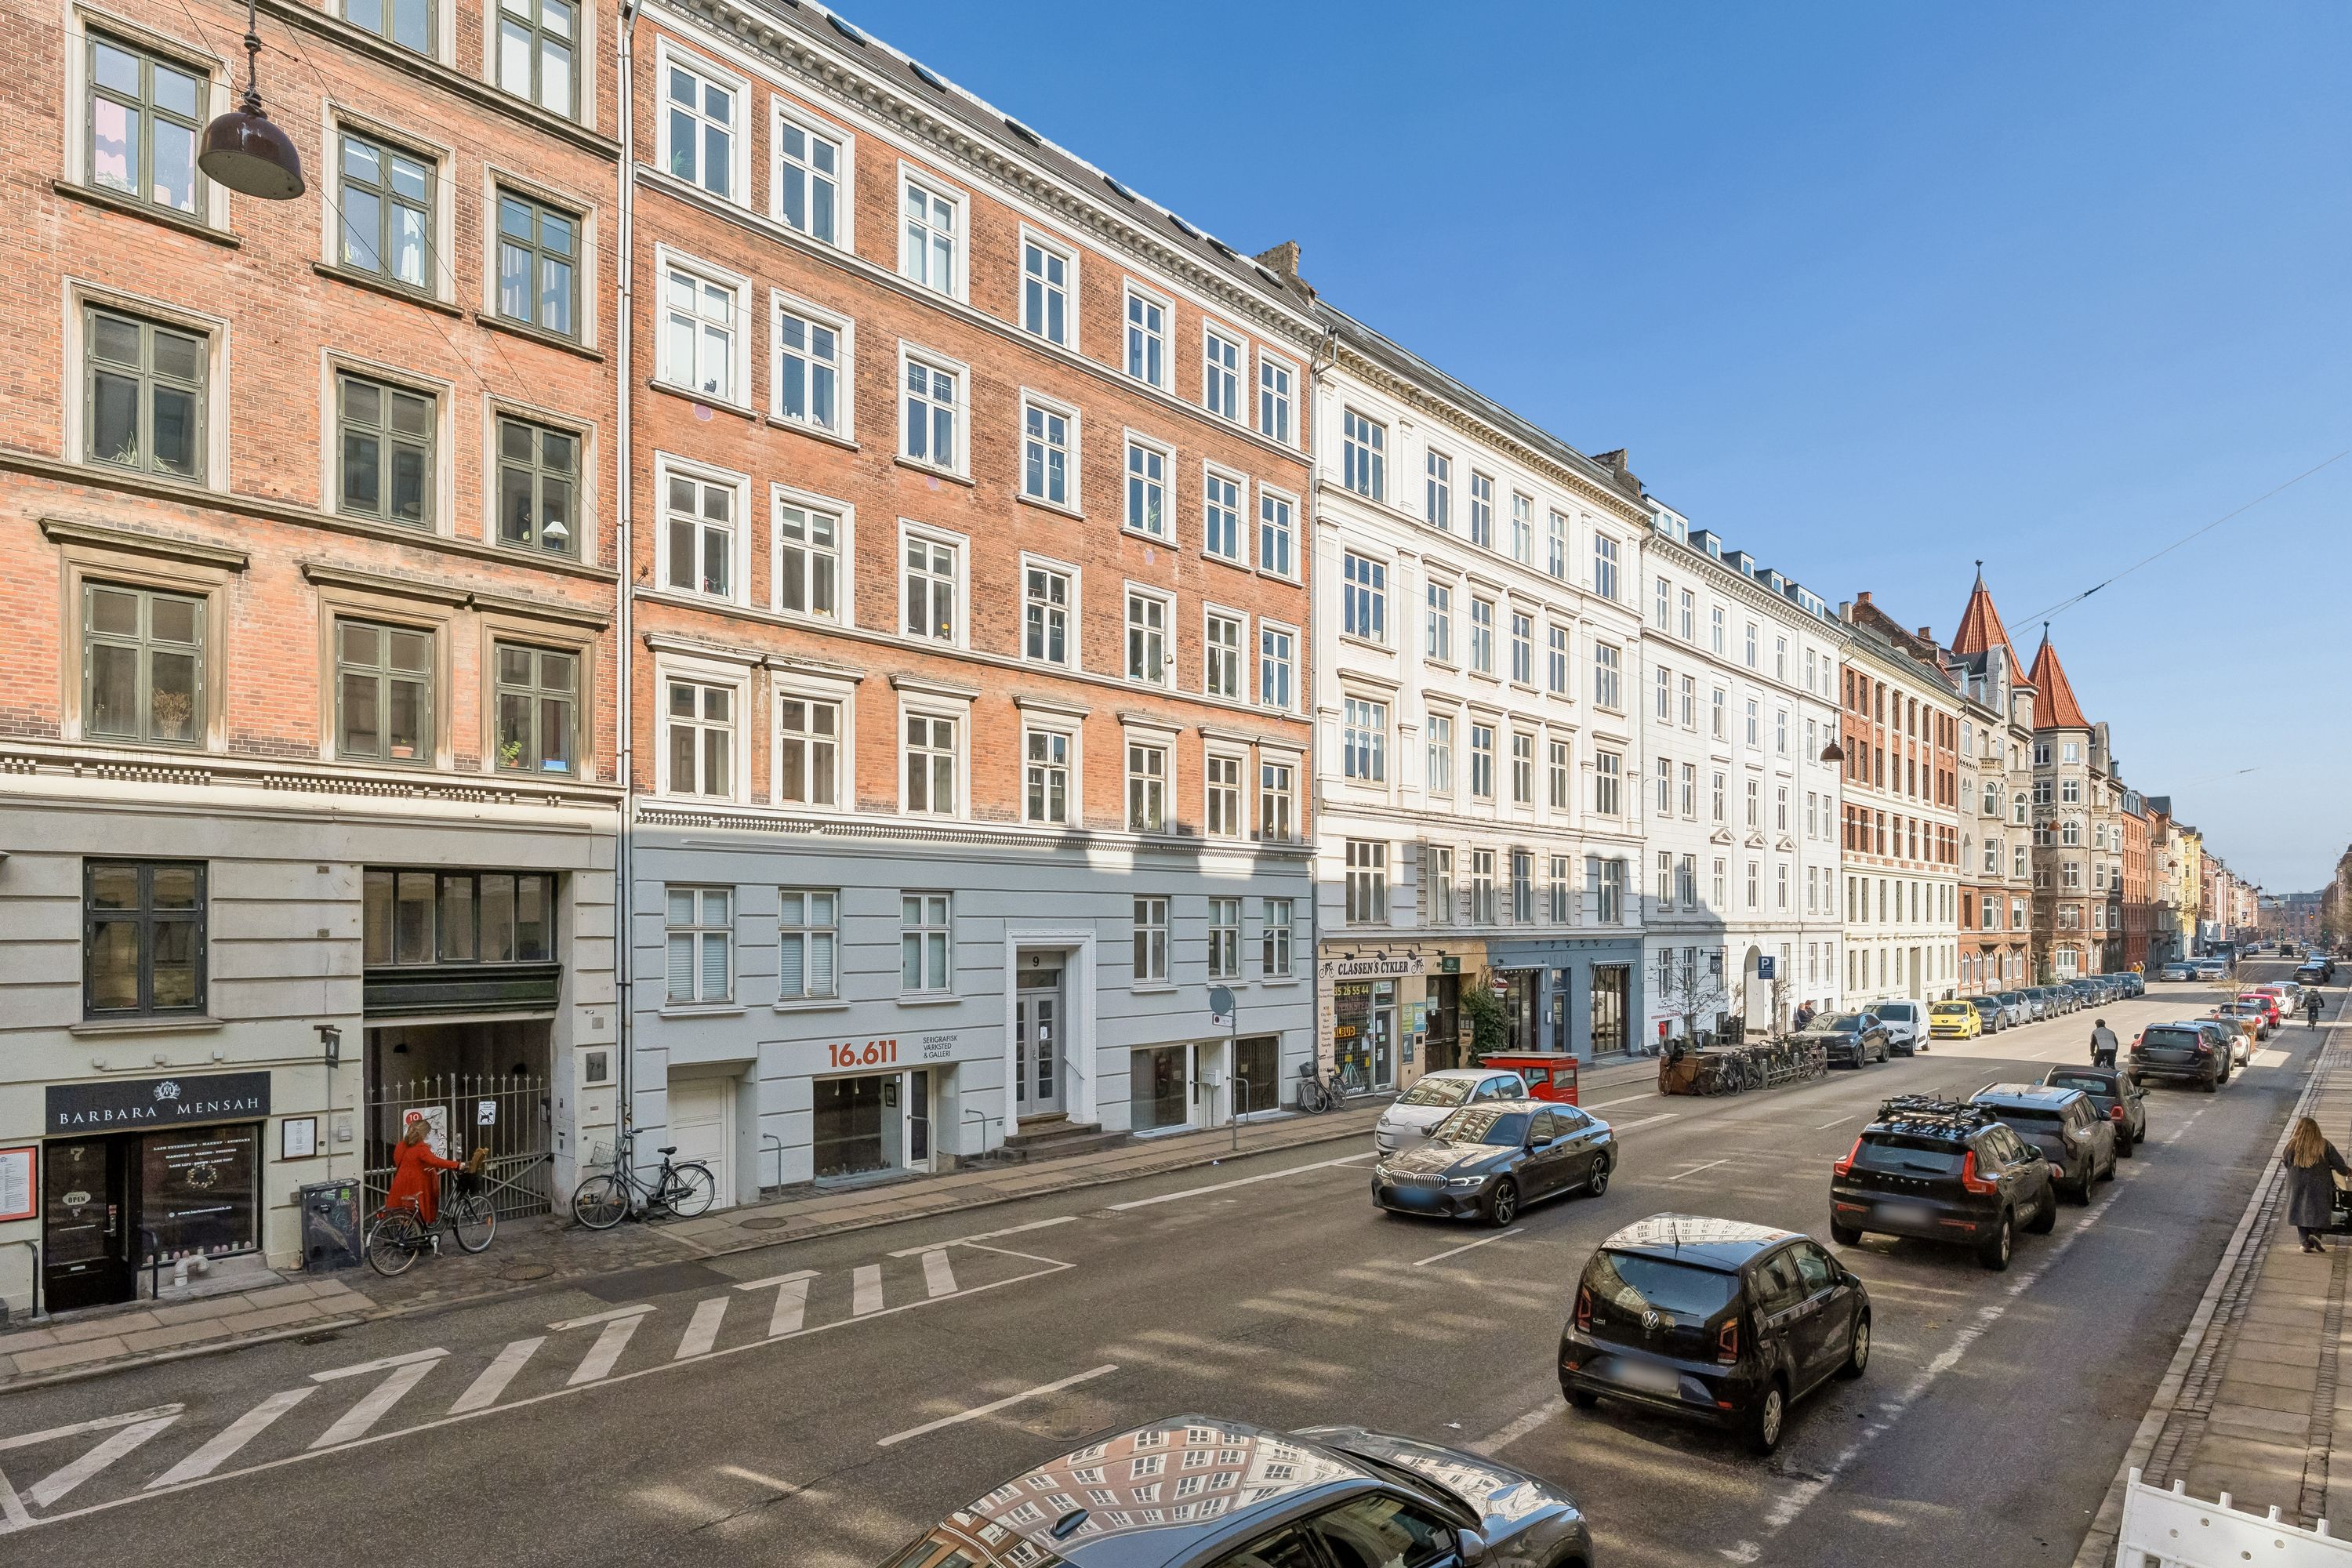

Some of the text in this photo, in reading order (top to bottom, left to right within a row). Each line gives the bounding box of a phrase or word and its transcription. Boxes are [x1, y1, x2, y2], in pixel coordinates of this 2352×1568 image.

[1033, 956, 1040, 967] 9
[1338, 960, 1409, 975] CLASSEN'S CYKLER
[1343, 986, 1351, 996] 26
[1352, 985, 1360, 995] 55
[1361, 985, 1370, 994] 44
[1334, 1027, 1355, 1037] ILBUD
[923, 1035, 958, 1044] SERIGRAFISK
[923, 1043, 952, 1051] VÆRKSTED
[829, 1040, 897, 1067] 16.611
[928, 1050, 951, 1058] GALLERI
[60, 1098, 260, 1125] BARBARA MENSAH
[70, 1147, 85, 1161] 7
[1876, 1175, 1929, 1185] VOLVO
[177, 1205, 233, 1216] www.barbaramensah.dk
